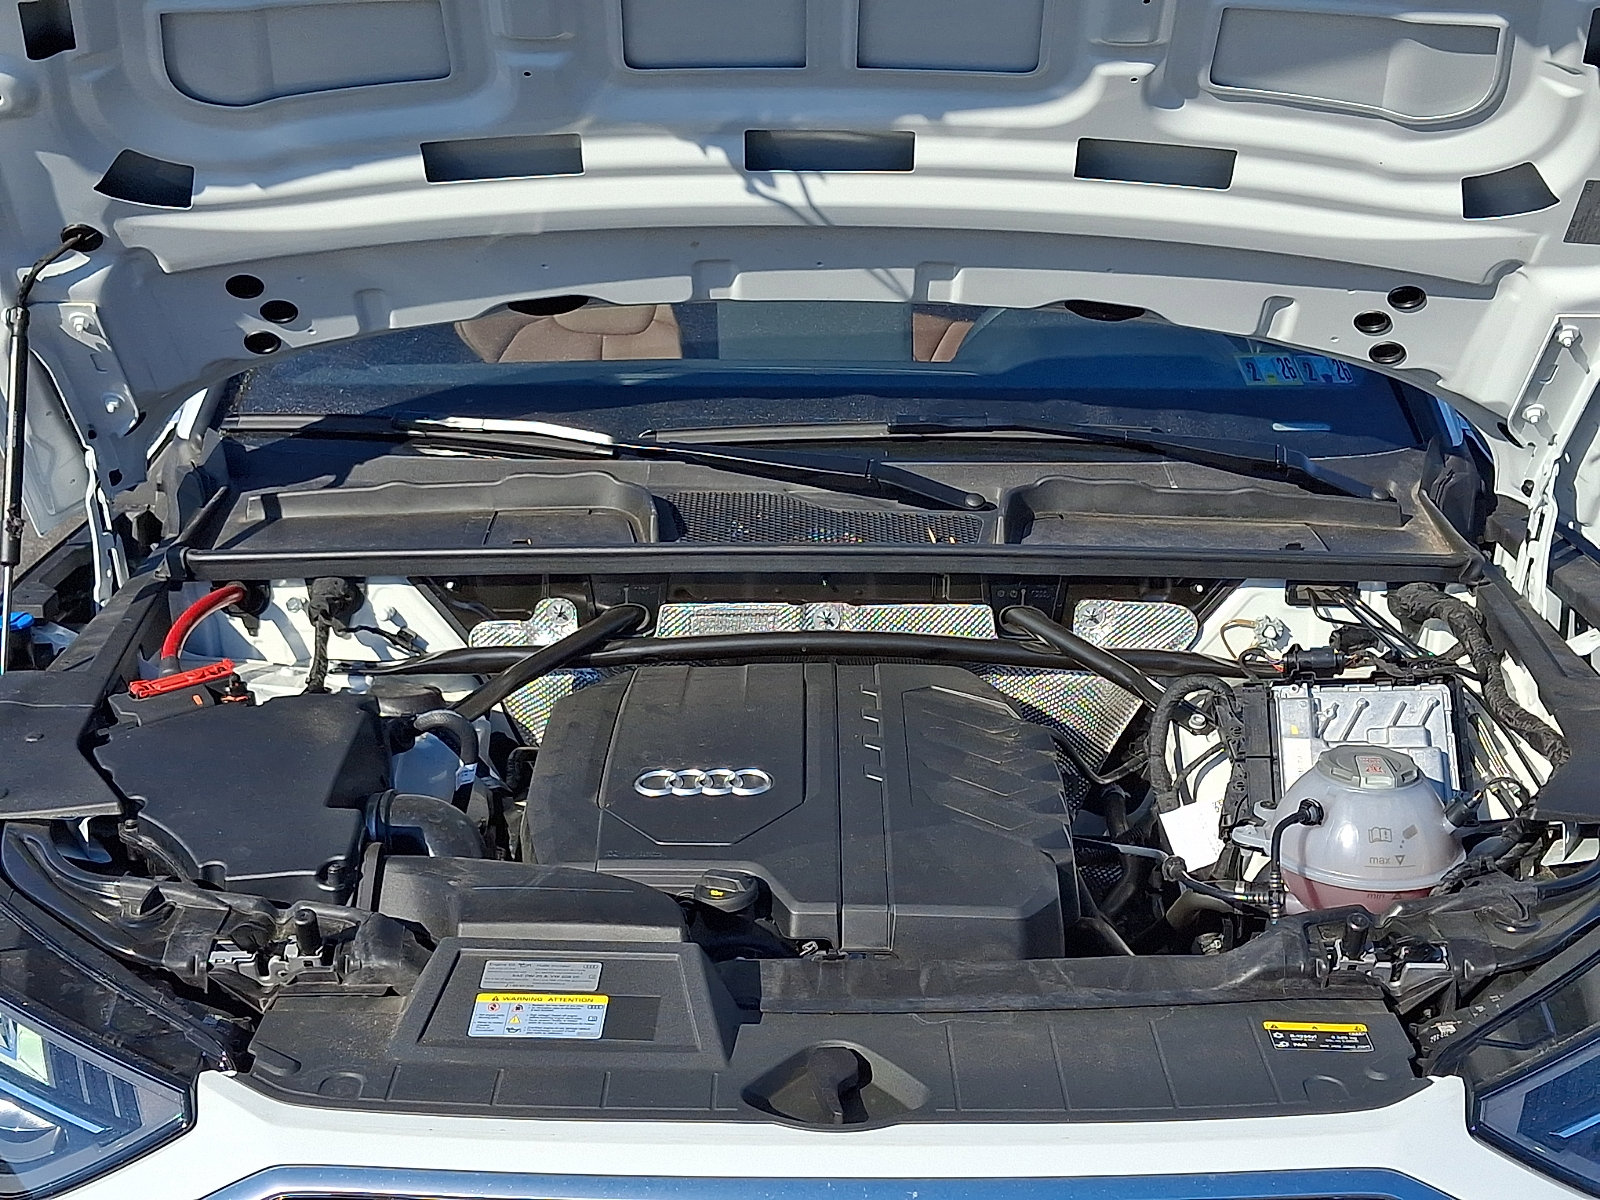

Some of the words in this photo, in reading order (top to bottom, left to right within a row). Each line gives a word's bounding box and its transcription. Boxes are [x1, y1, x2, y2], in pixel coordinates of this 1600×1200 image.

[1245, 361, 1262, 382] 2
[1275, 357, 1298, 380] 26
[1302, 361, 1318, 382] 2
[1331, 358, 1353, 381] 26
[1369, 856, 1391, 865] max
